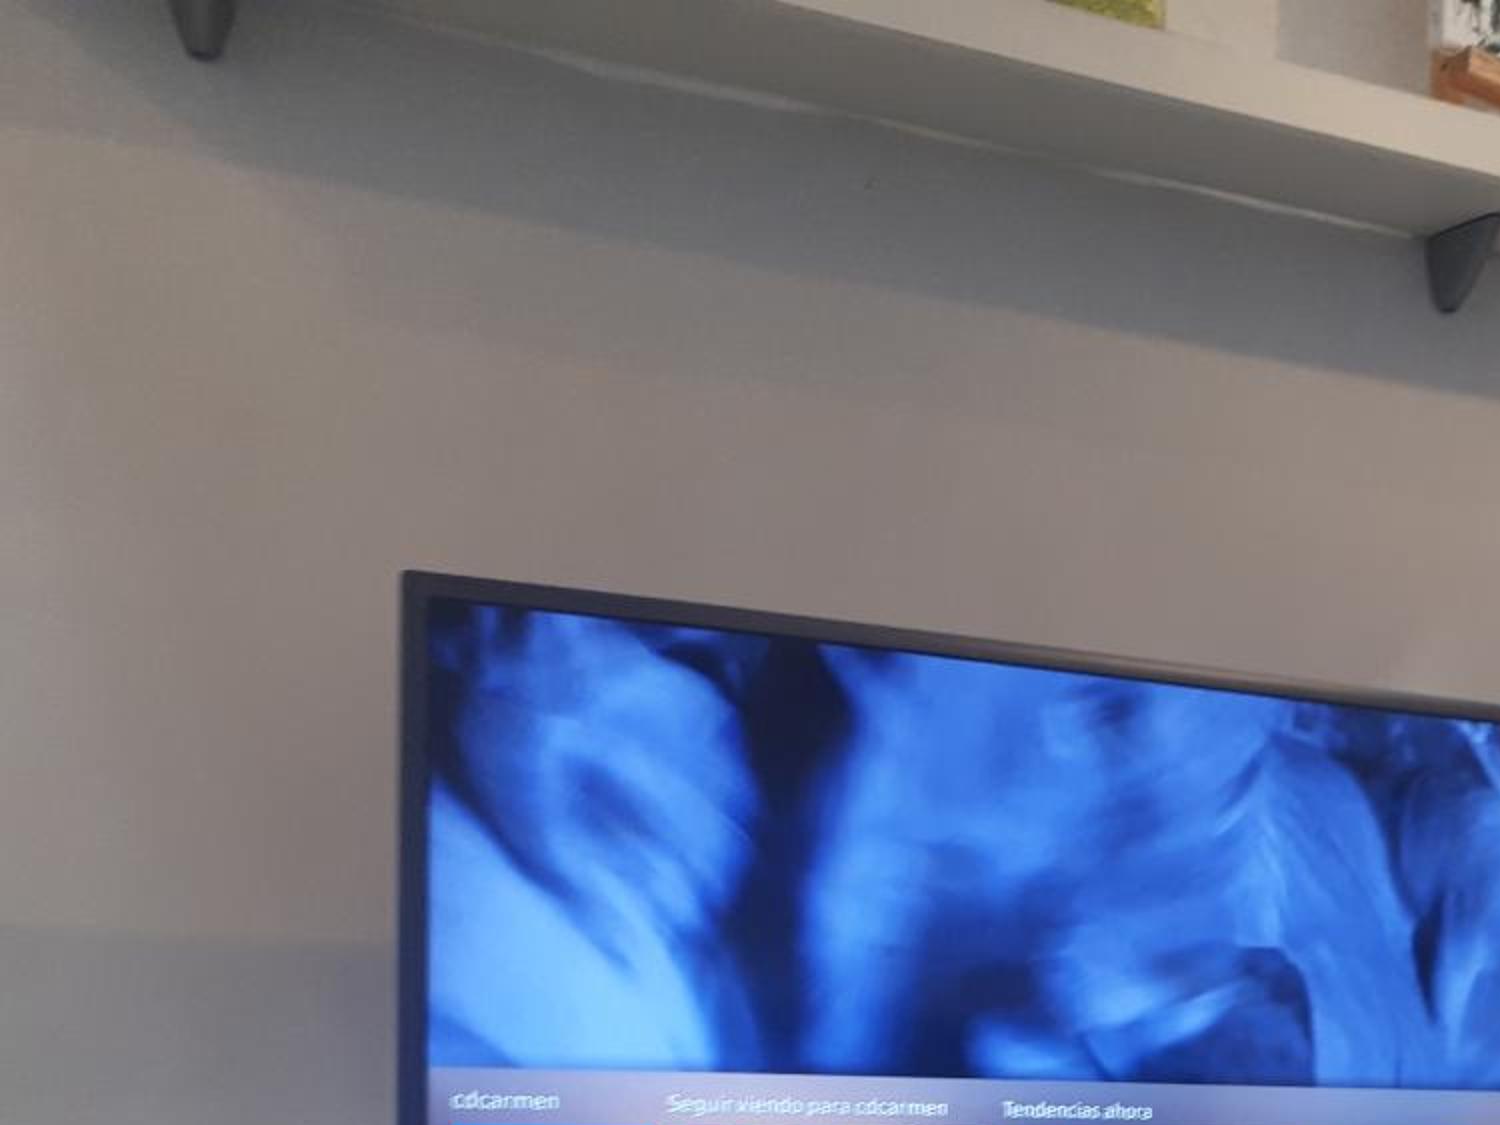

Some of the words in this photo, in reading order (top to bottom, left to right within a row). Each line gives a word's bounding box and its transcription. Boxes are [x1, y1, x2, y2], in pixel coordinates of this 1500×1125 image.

[452, 1090, 561, 1112] cdcarmen
[667, 1093, 733, 1118] Seguir
[737, 1096, 804, 1116] viendo
[806, 1101, 850, 1117] para
[1002, 1101, 1100, 1119] Tendencias
[1103, 1103, 1153, 1121] ahora
